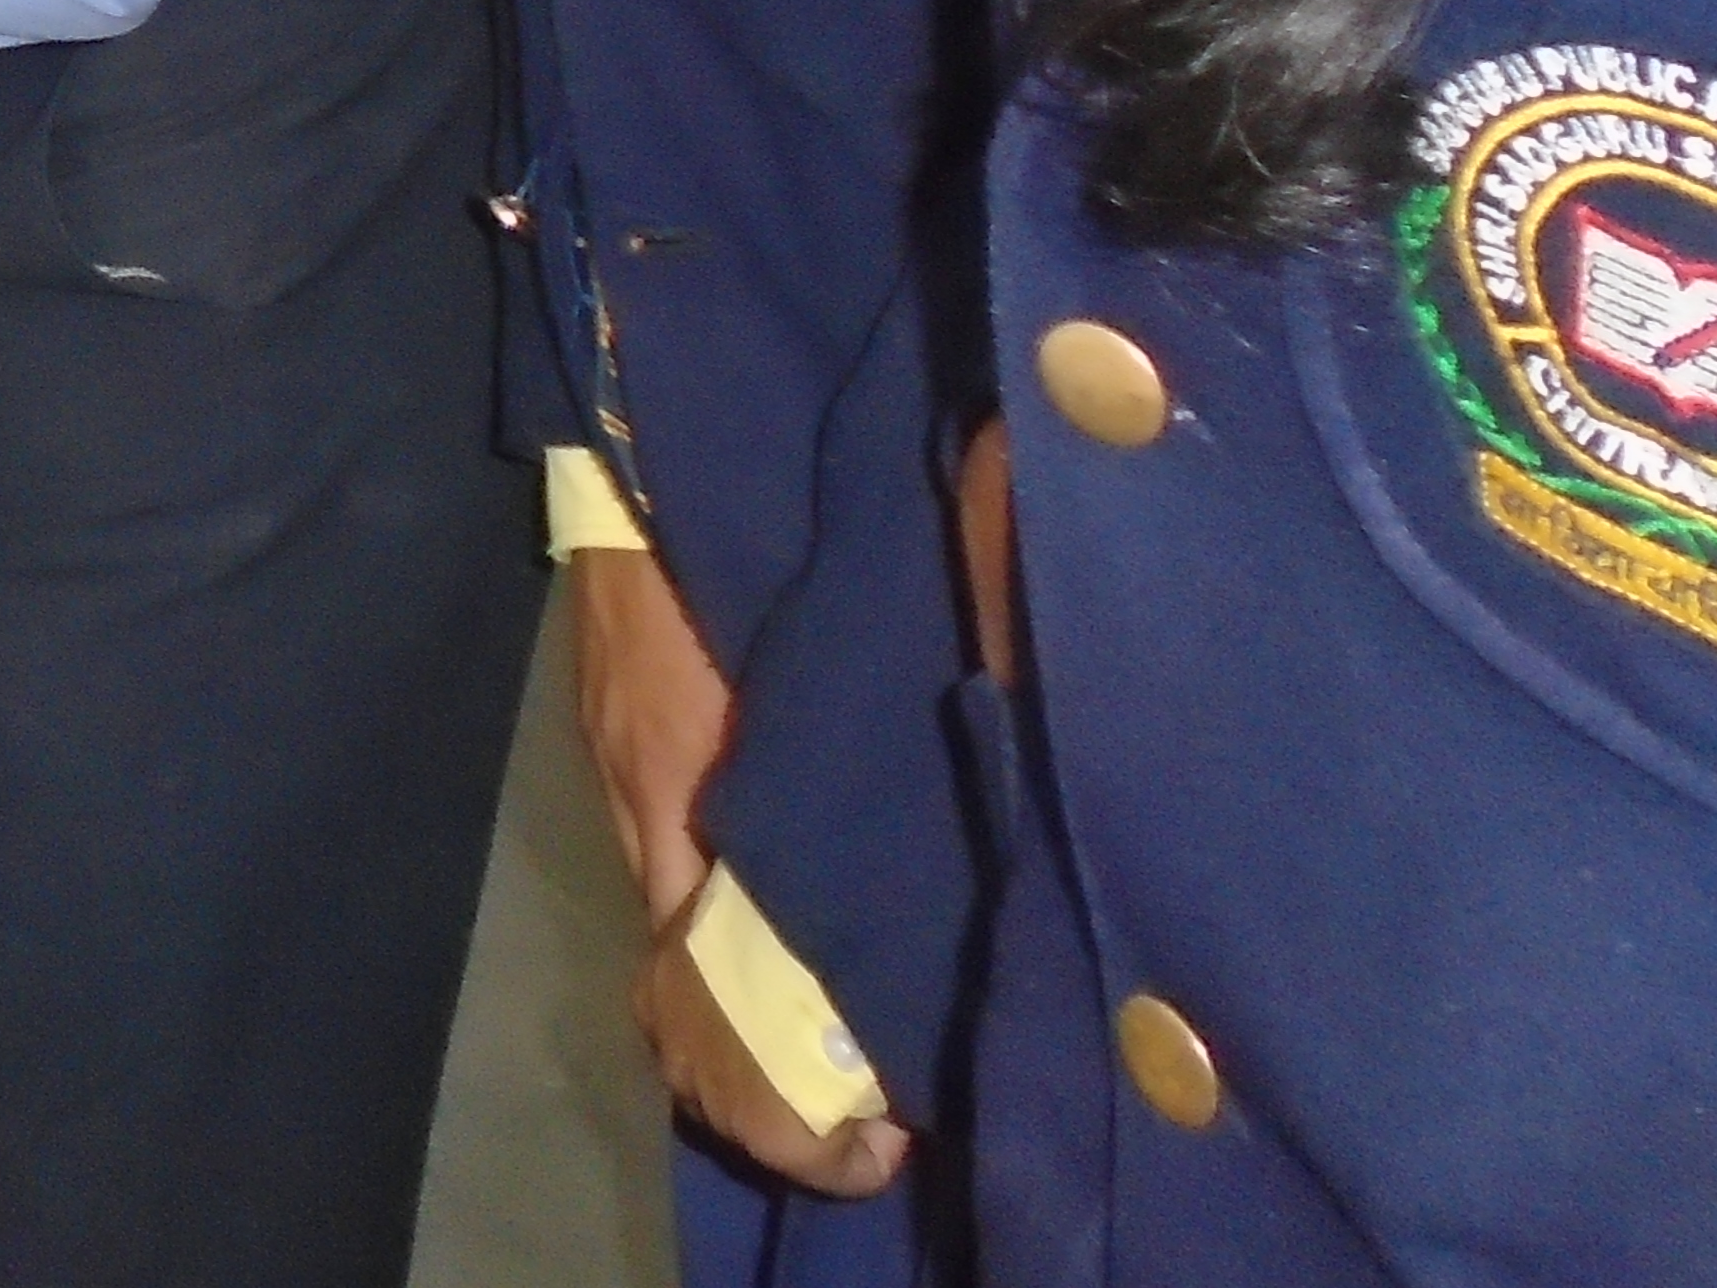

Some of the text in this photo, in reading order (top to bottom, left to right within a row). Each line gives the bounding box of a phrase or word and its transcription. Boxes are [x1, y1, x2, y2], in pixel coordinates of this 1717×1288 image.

[1530, 44, 1697, 110] PUBLIC
[1482, 113, 1668, 213] SADGURU
[1473, 201, 1527, 308] SHRI
